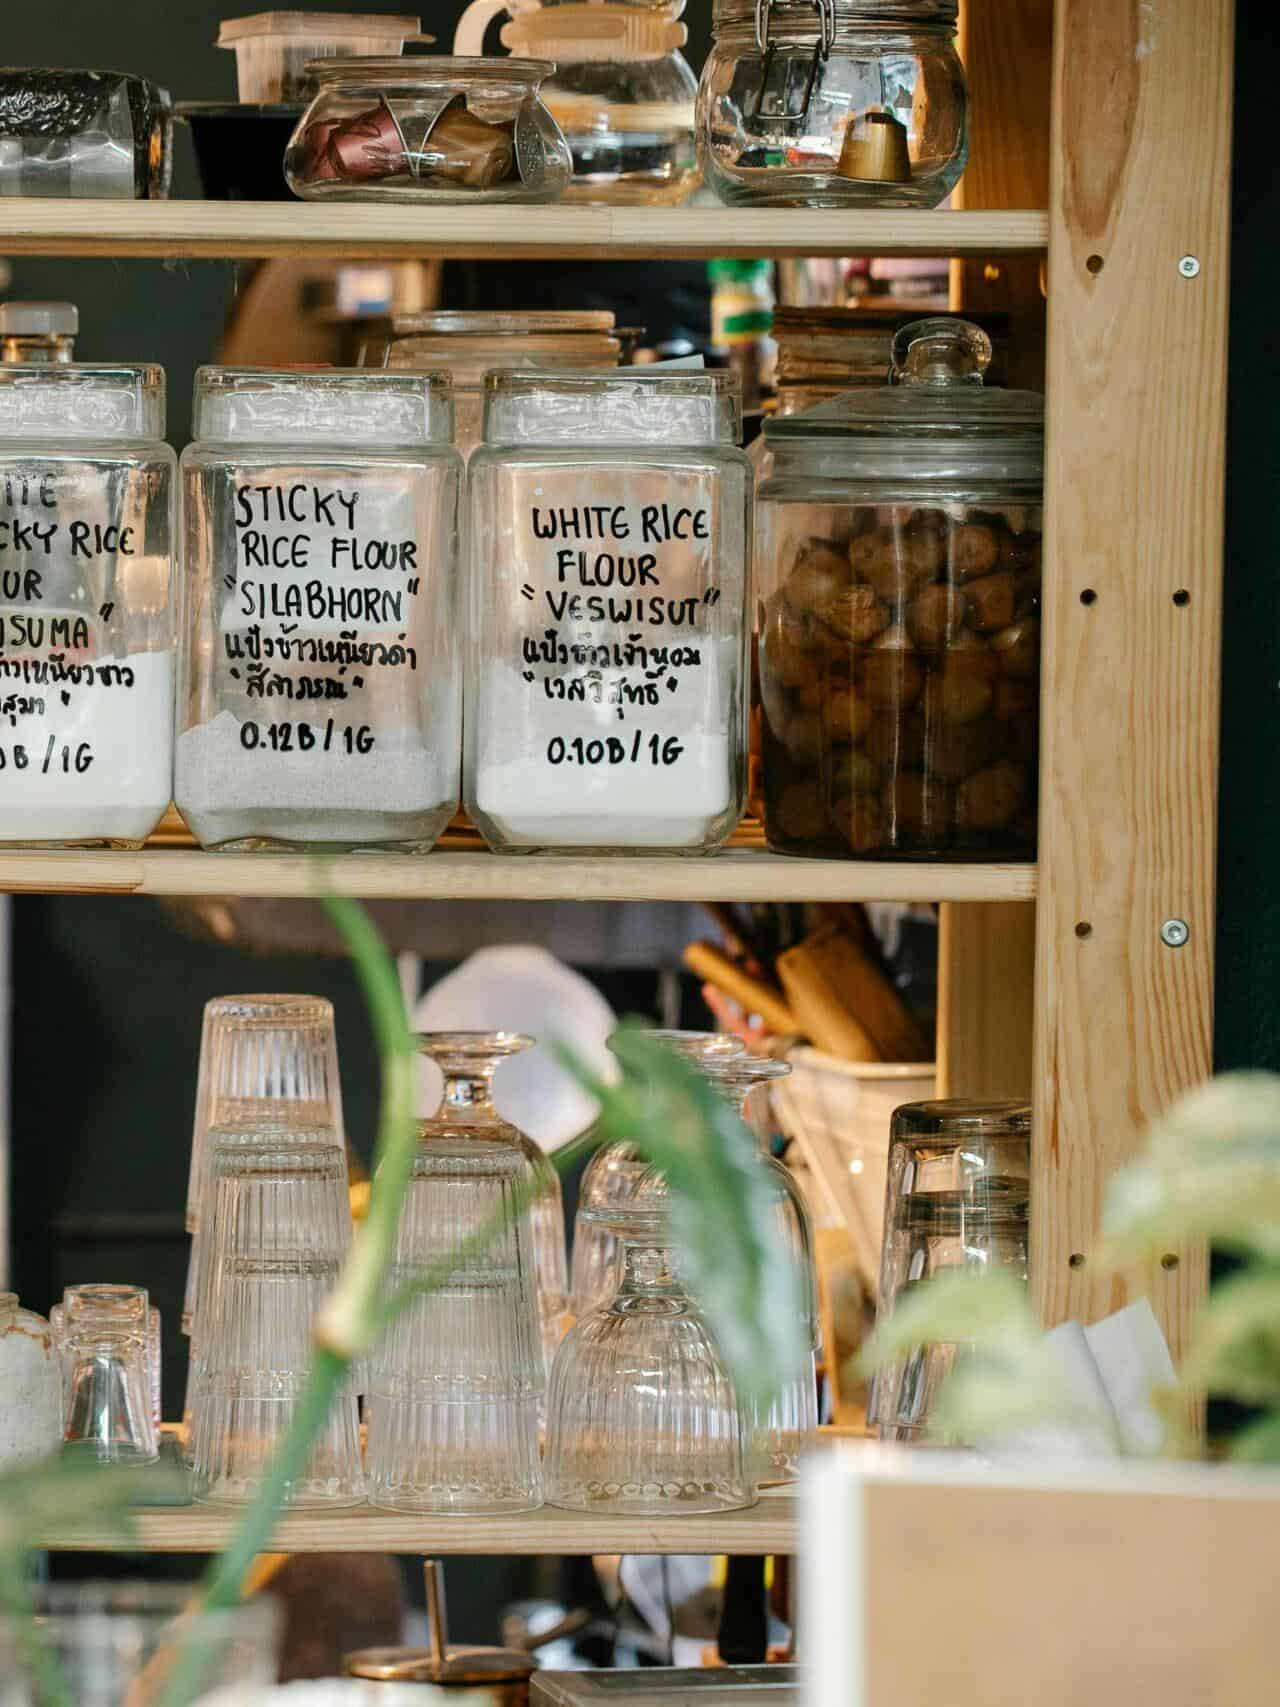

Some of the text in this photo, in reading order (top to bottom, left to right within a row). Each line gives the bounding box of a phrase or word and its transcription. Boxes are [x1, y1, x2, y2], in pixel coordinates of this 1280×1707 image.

[235, 484, 359, 530] STICKY
[532, 504, 709, 543] WHITE RICE
[70, 521, 134, 558] RICE
[242, 531, 417, 571] RICE FLOUR
[557, 550, 660, 587] FLOUR
